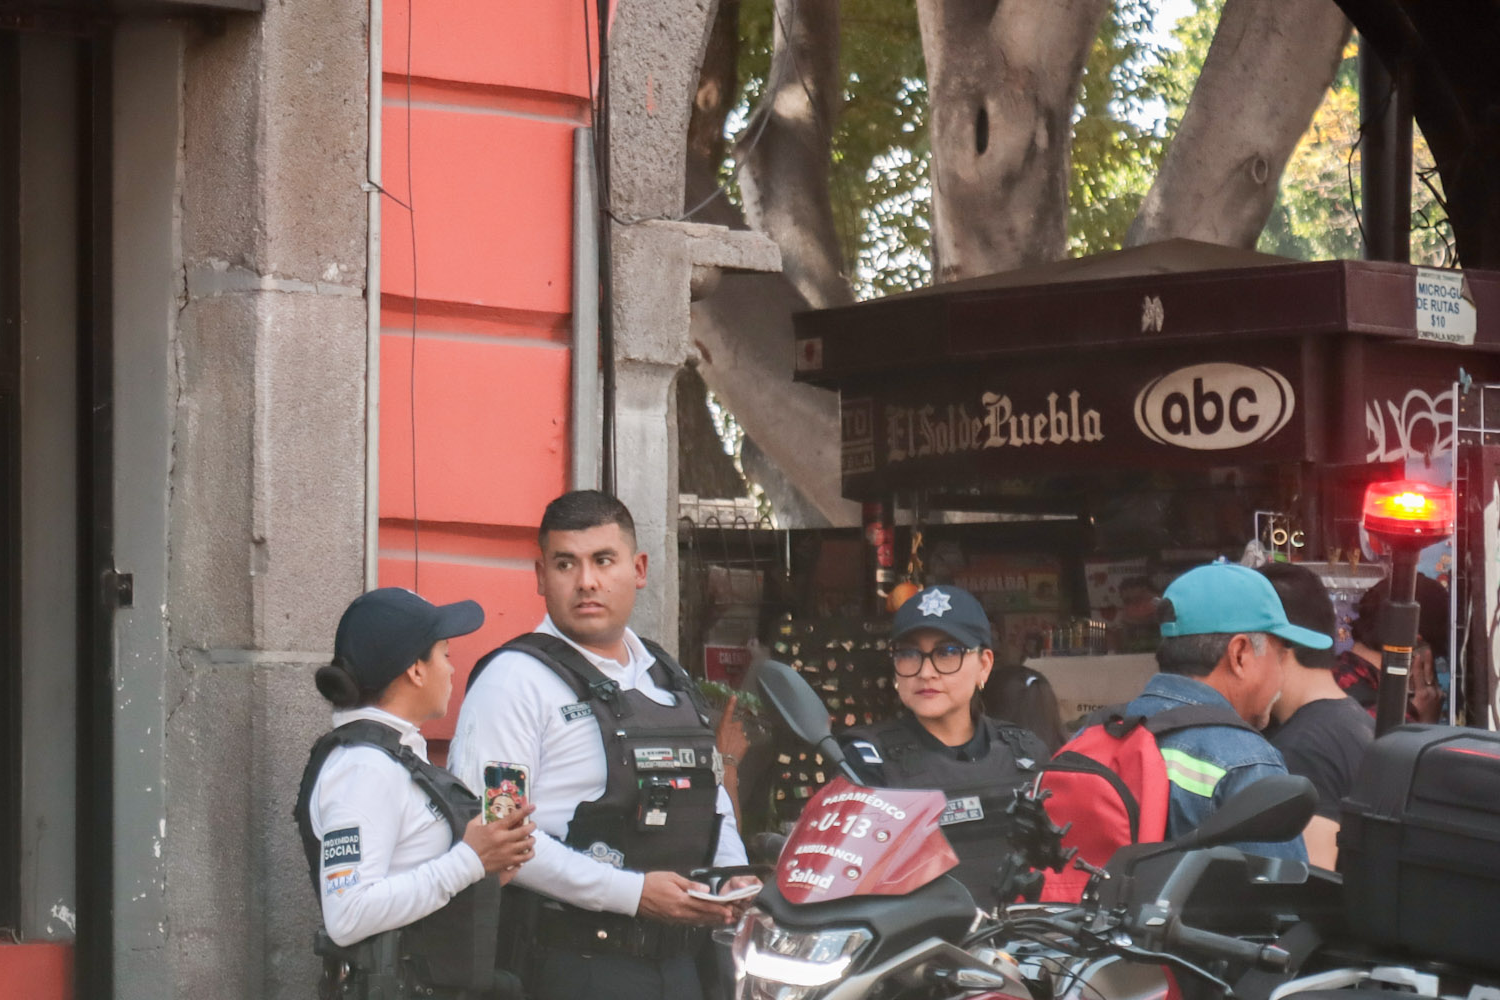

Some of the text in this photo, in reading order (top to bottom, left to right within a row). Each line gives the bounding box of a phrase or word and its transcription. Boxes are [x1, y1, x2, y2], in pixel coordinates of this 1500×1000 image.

[1416, 297, 1460, 315] DE RUTAS
[1431, 314, 1446, 328] $10
[1162, 376, 1260, 434] abc
[885, 404, 916, 463] El
[982, 390, 1105, 449] Puebla
[822, 791, 907, 820] PARAMÉDICO
[324, 844, 360, 860] SOCIAL
[795, 844, 863, 866] AMBULANCIA
[788, 868, 834, 890] Salud
